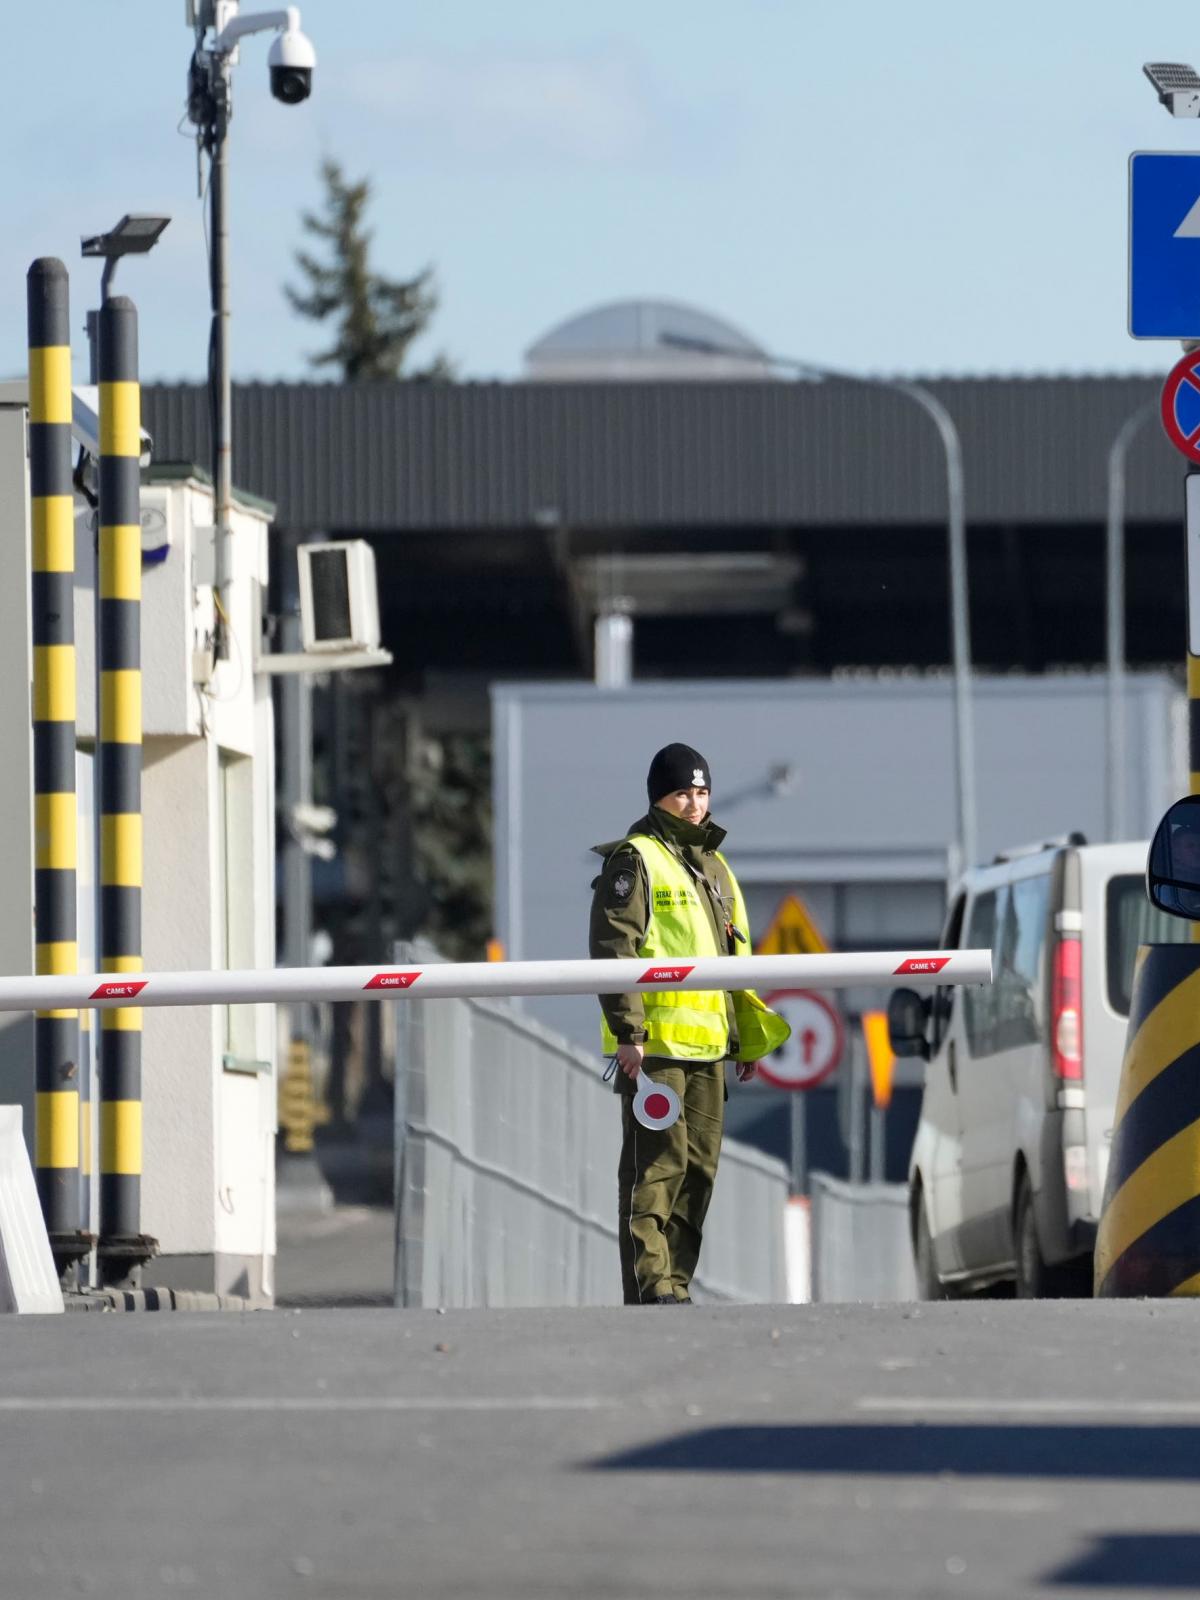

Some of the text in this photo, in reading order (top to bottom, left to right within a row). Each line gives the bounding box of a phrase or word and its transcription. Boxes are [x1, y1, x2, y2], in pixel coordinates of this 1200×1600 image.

[653, 971, 673, 979] CAME
[380, 977, 400, 985] CAME
[105, 987, 126, 995] CAME
